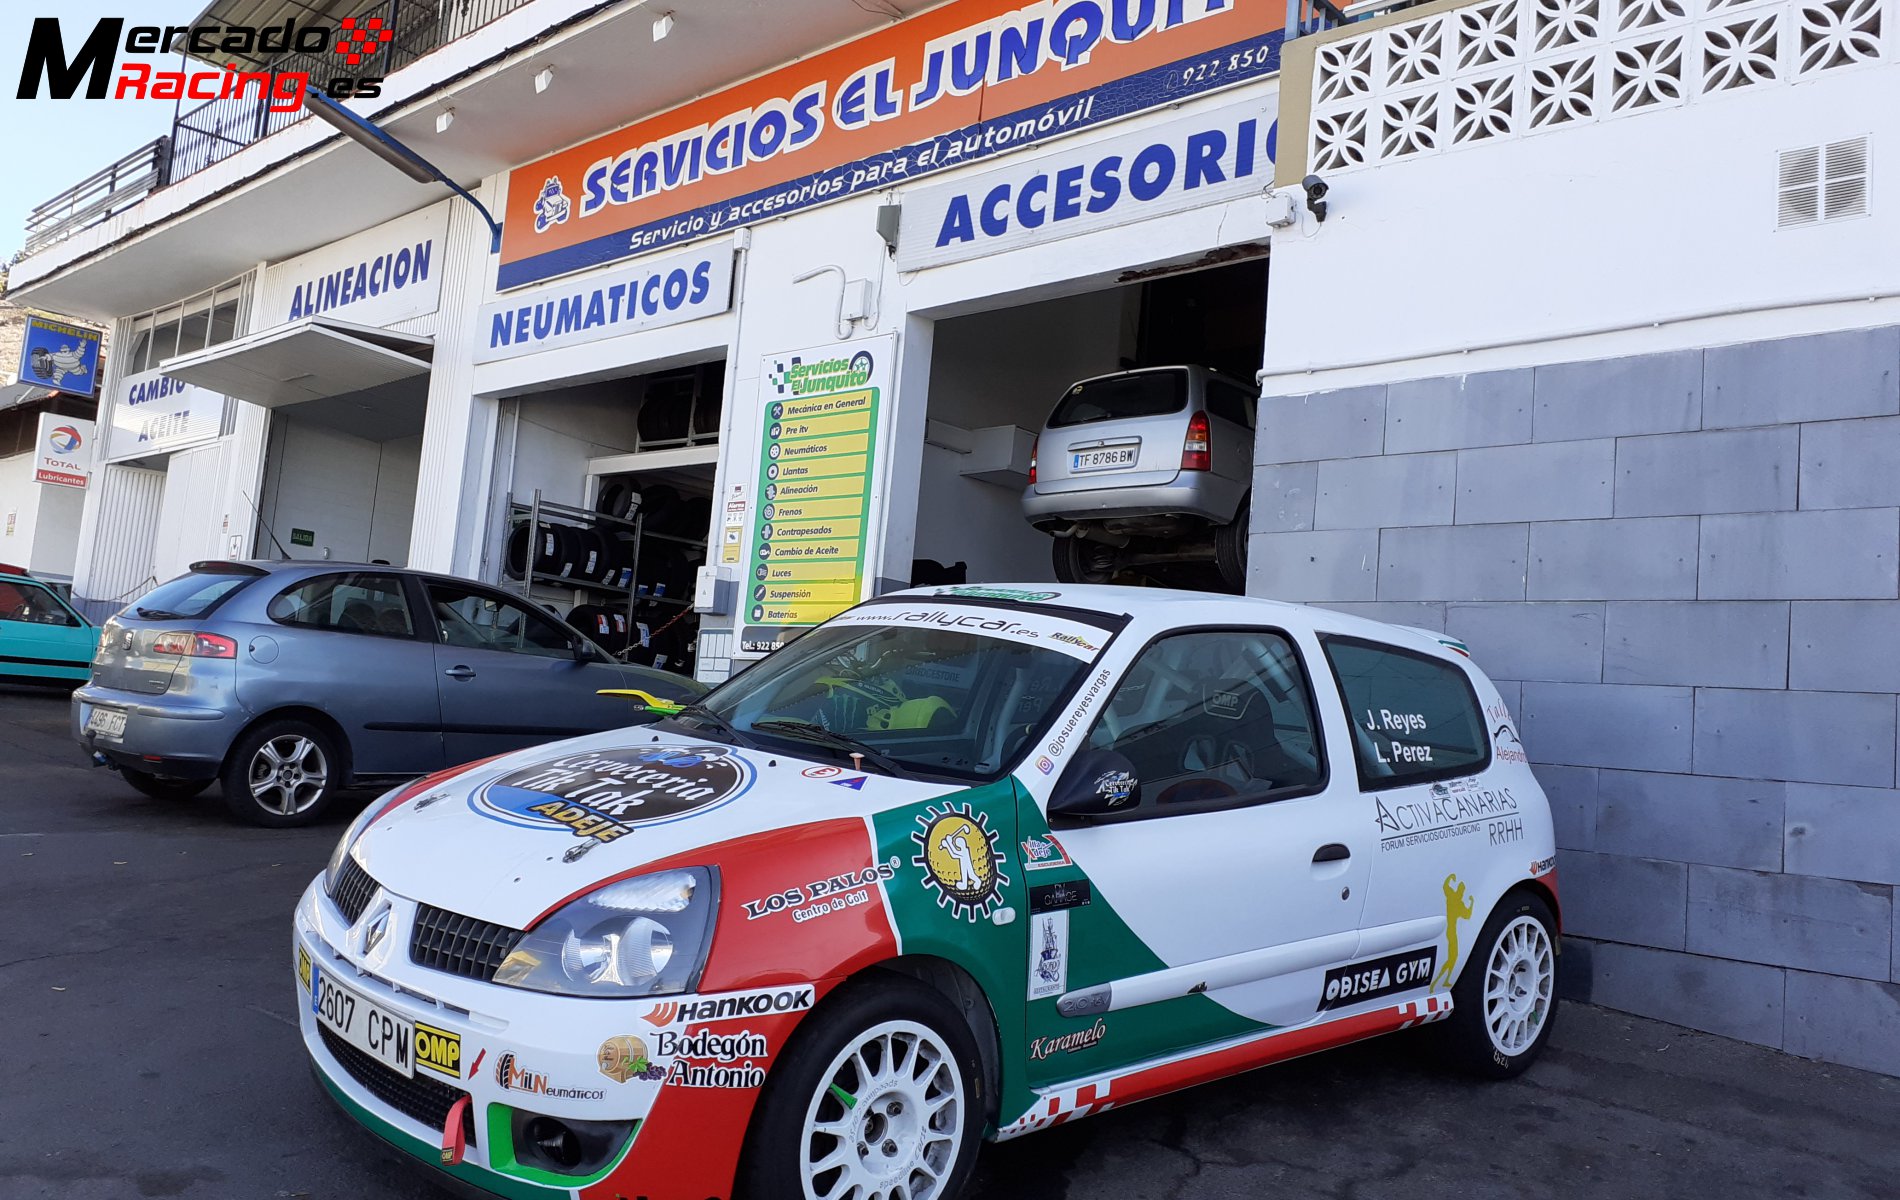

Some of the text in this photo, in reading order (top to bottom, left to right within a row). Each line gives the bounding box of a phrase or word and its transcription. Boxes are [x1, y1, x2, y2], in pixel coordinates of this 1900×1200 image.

[1183, 45, 1269, 86] 922 850
[581, 0, 1230, 214] SERVICIOS EL JUNQUI
[629, 94, 1097, 251] Servicio y accesorios para el automóvil
[289, 240, 432, 322] ALINEACION
[489, 260, 712, 349] NEUMATICOS
[31, 320, 99, 341] MICHELIN
[791, 359, 849, 379] Servicios
[128, 376, 187, 406] CAMBIO
[799, 371, 867, 394] Junquito
[787, 397, 866, 415] Mecánica en General
[138, 410, 190, 442] ACEITE
[786, 424, 808, 435] Pre itv
[784, 444, 827, 456] Neumáticos
[1080, 450, 1134, 466] TF 8786 BW
[44, 457, 81, 471] TOTAL
[782, 466, 808, 476] Llantas
[38, 470, 85, 486] Lubricantes
[780, 484, 818, 495] Alineación
[778, 508, 802, 517] Frenos
[777, 526, 832, 537] Contrapesados
[775, 546, 839, 556] Cambio de Aceite
[772, 569, 792, 577] Luces
[770, 589, 811, 599] Suspensión
[768, 610, 798, 619] Baterías
[756, 641, 770, 650] 922
[1212, 693, 1238, 707] OMP
[1048, 668, 1111, 756] @josuereyesvargas
[1366, 709, 1427, 735] J. Reyes
[1375, 741, 1433, 763] L. Perez
[553, 753, 718, 802] Cerveceria
[529, 801, 630, 843] ADEJE
[1488, 818, 1524, 846] RRHH
[1381, 836, 1405, 852] FORUM
[744, 890, 803, 918] LOS
[794, 891, 867, 921] Centro de Golf
[1325, 957, 1431, 1001] ODISEA GYM
[318, 976, 409, 1069] 2607 CPM
[415, 1032, 460, 1068] OMP
[650, 1029, 767, 1061] Bodegón
[1030, 1018, 1106, 1060] Karamelo
[668, 1061, 764, 1088] Antonio
